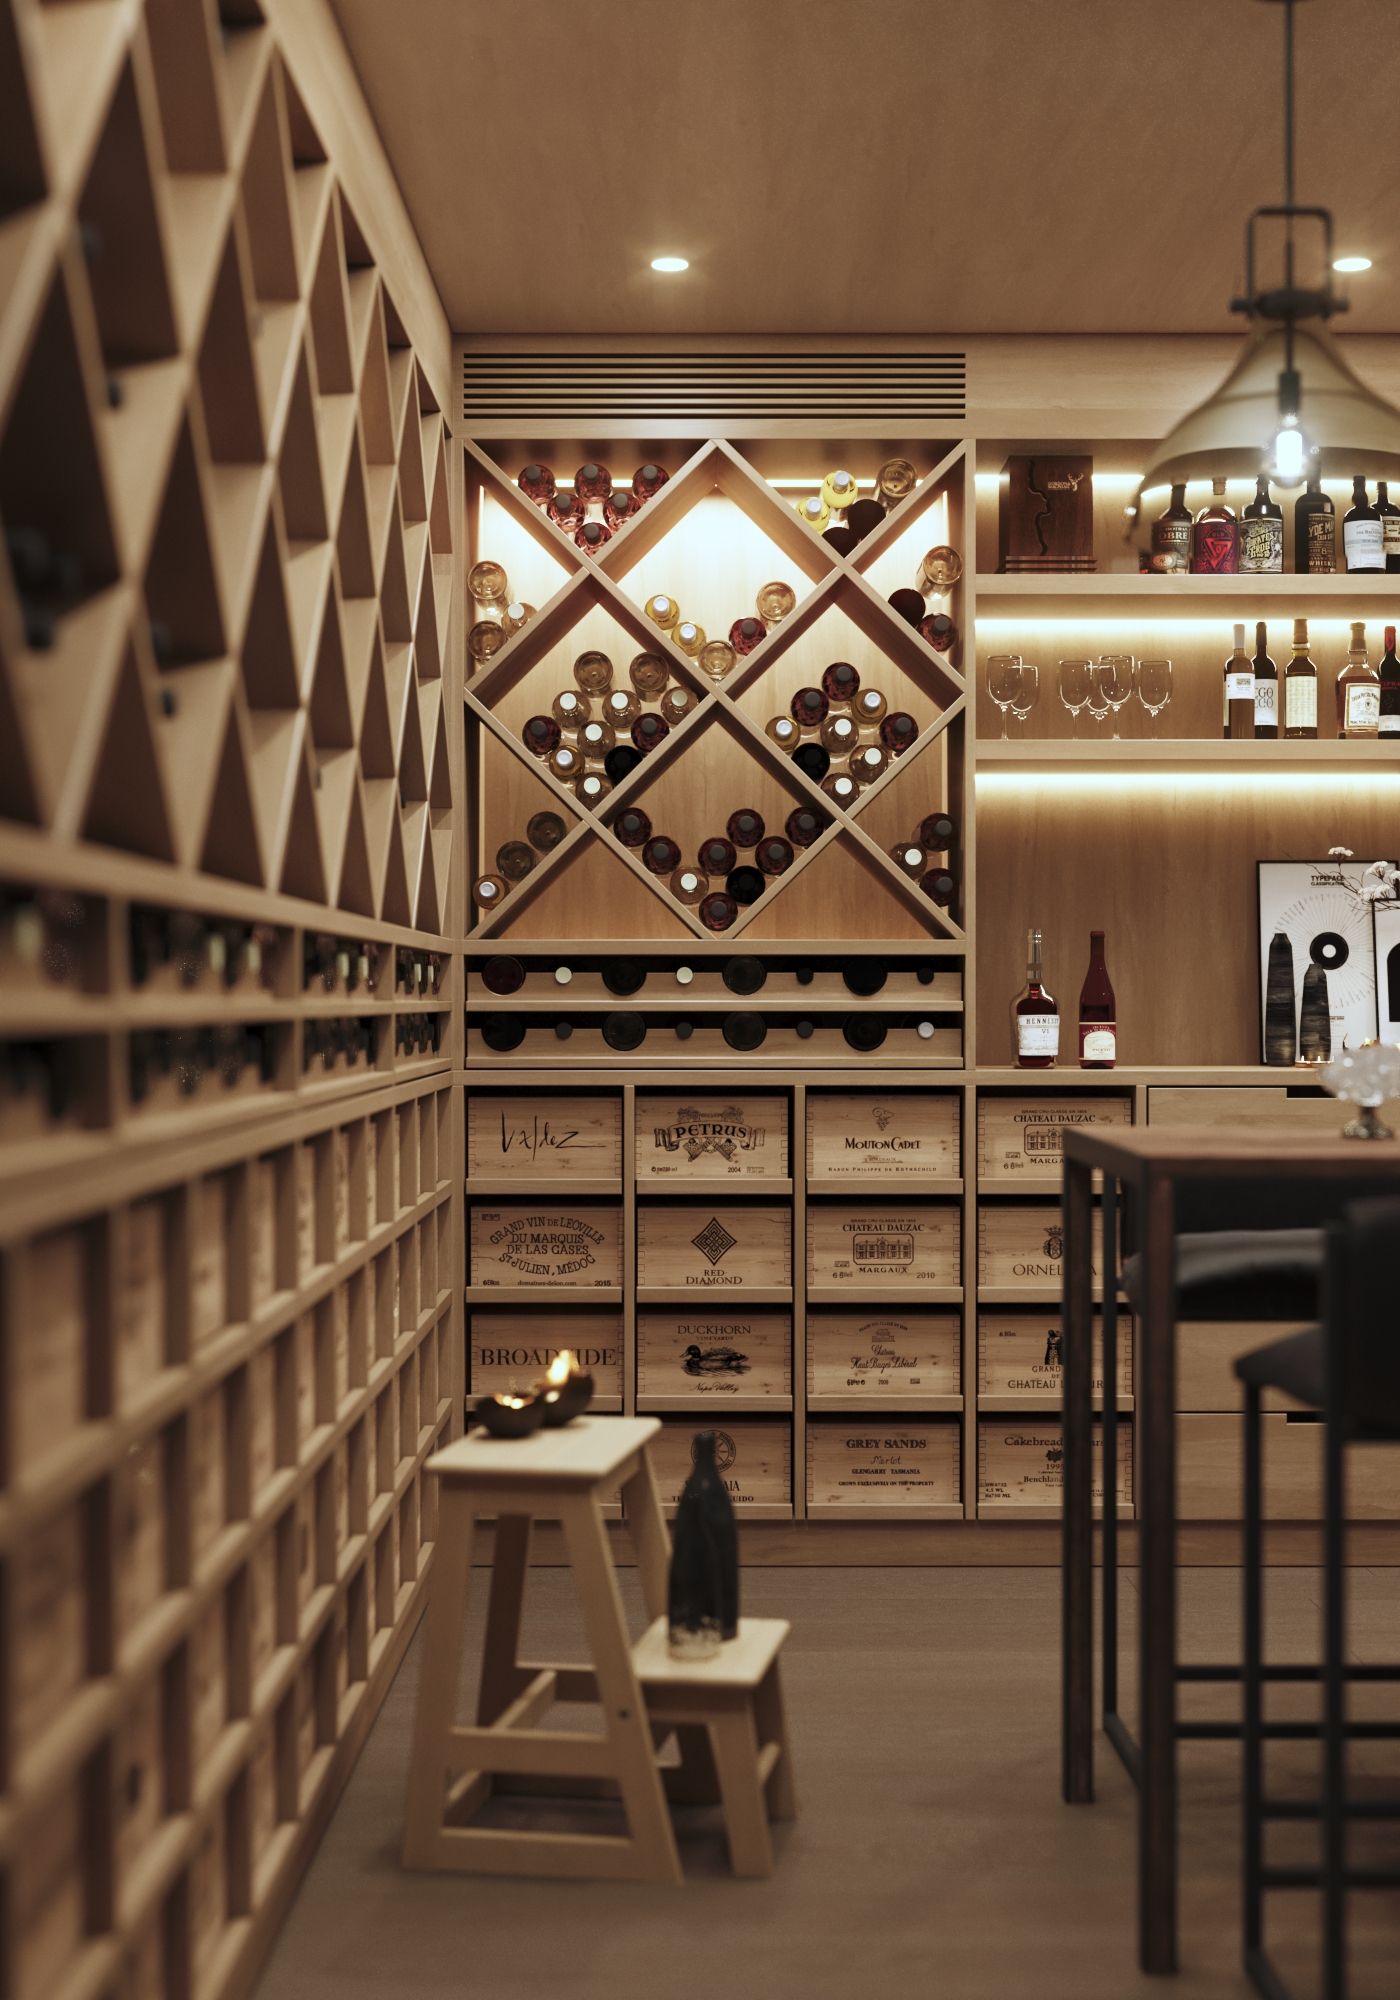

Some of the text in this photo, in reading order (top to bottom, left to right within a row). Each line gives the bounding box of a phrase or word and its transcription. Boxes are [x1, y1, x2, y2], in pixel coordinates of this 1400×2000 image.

[1058, 1115, 1096, 1123] DAUZAC
[675, 1123, 747, 1139] PETRUS
[490, 1220, 525, 1245] GRAND
[526, 1216, 546, 1228] VIN
[547, 1218, 559, 1227] DE
[887, 1224, 925, 1232] DAUZAC
[511, 1233, 584, 1245] DU MARQUIS
[506, 1244, 589, 1255] DE LAS CASES
[498, 1252, 512, 1264] ST
[704, 1269, 725, 1277] RED
[1013, 1263, 1097, 1276] ORNELA
[686, 1276, 743, 1285] DIAMOND
[677, 1325, 751, 1335] DUCKHORN
[480, 1349, 616, 1366] BROADIDE
[1032, 1365, 1061, 1373] GRAND
[846, 1438, 927, 1449] GREY SANDS
[1004, 1437, 1063, 1446] Cakebread
[870, 1456, 902, 1465] Merlot
